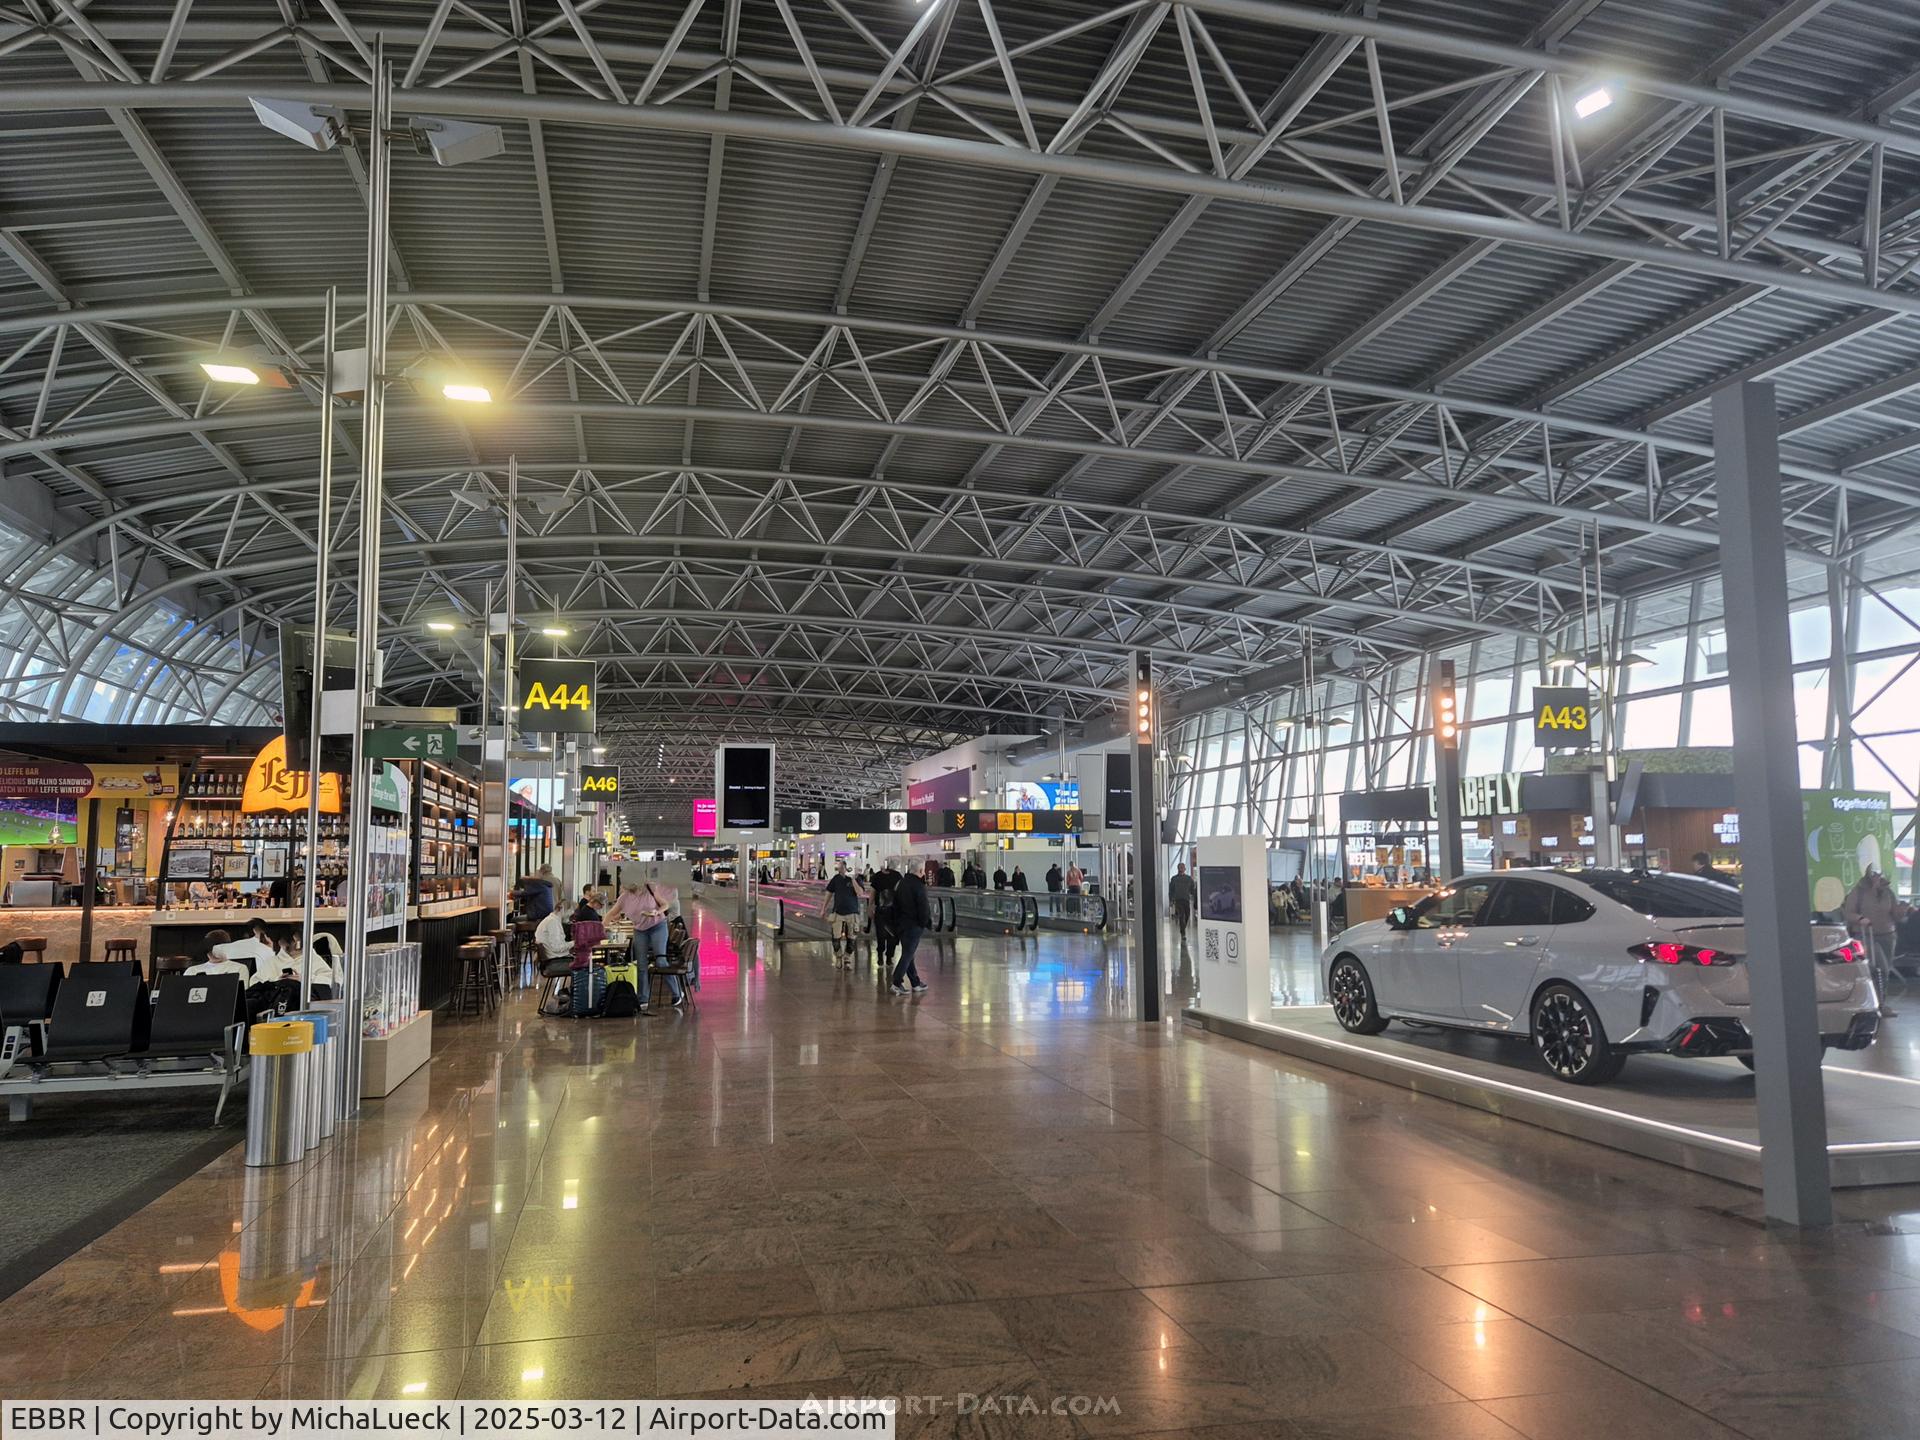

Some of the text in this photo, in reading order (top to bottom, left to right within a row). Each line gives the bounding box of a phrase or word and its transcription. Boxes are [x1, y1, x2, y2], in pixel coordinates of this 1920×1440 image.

[524, 682, 591, 711] A44
[1538, 704, 1587, 730] A43
[25, 767, 39, 775] BAR
[58, 778, 92, 786] SANDWICH
[583, 776, 617, 791] A46
